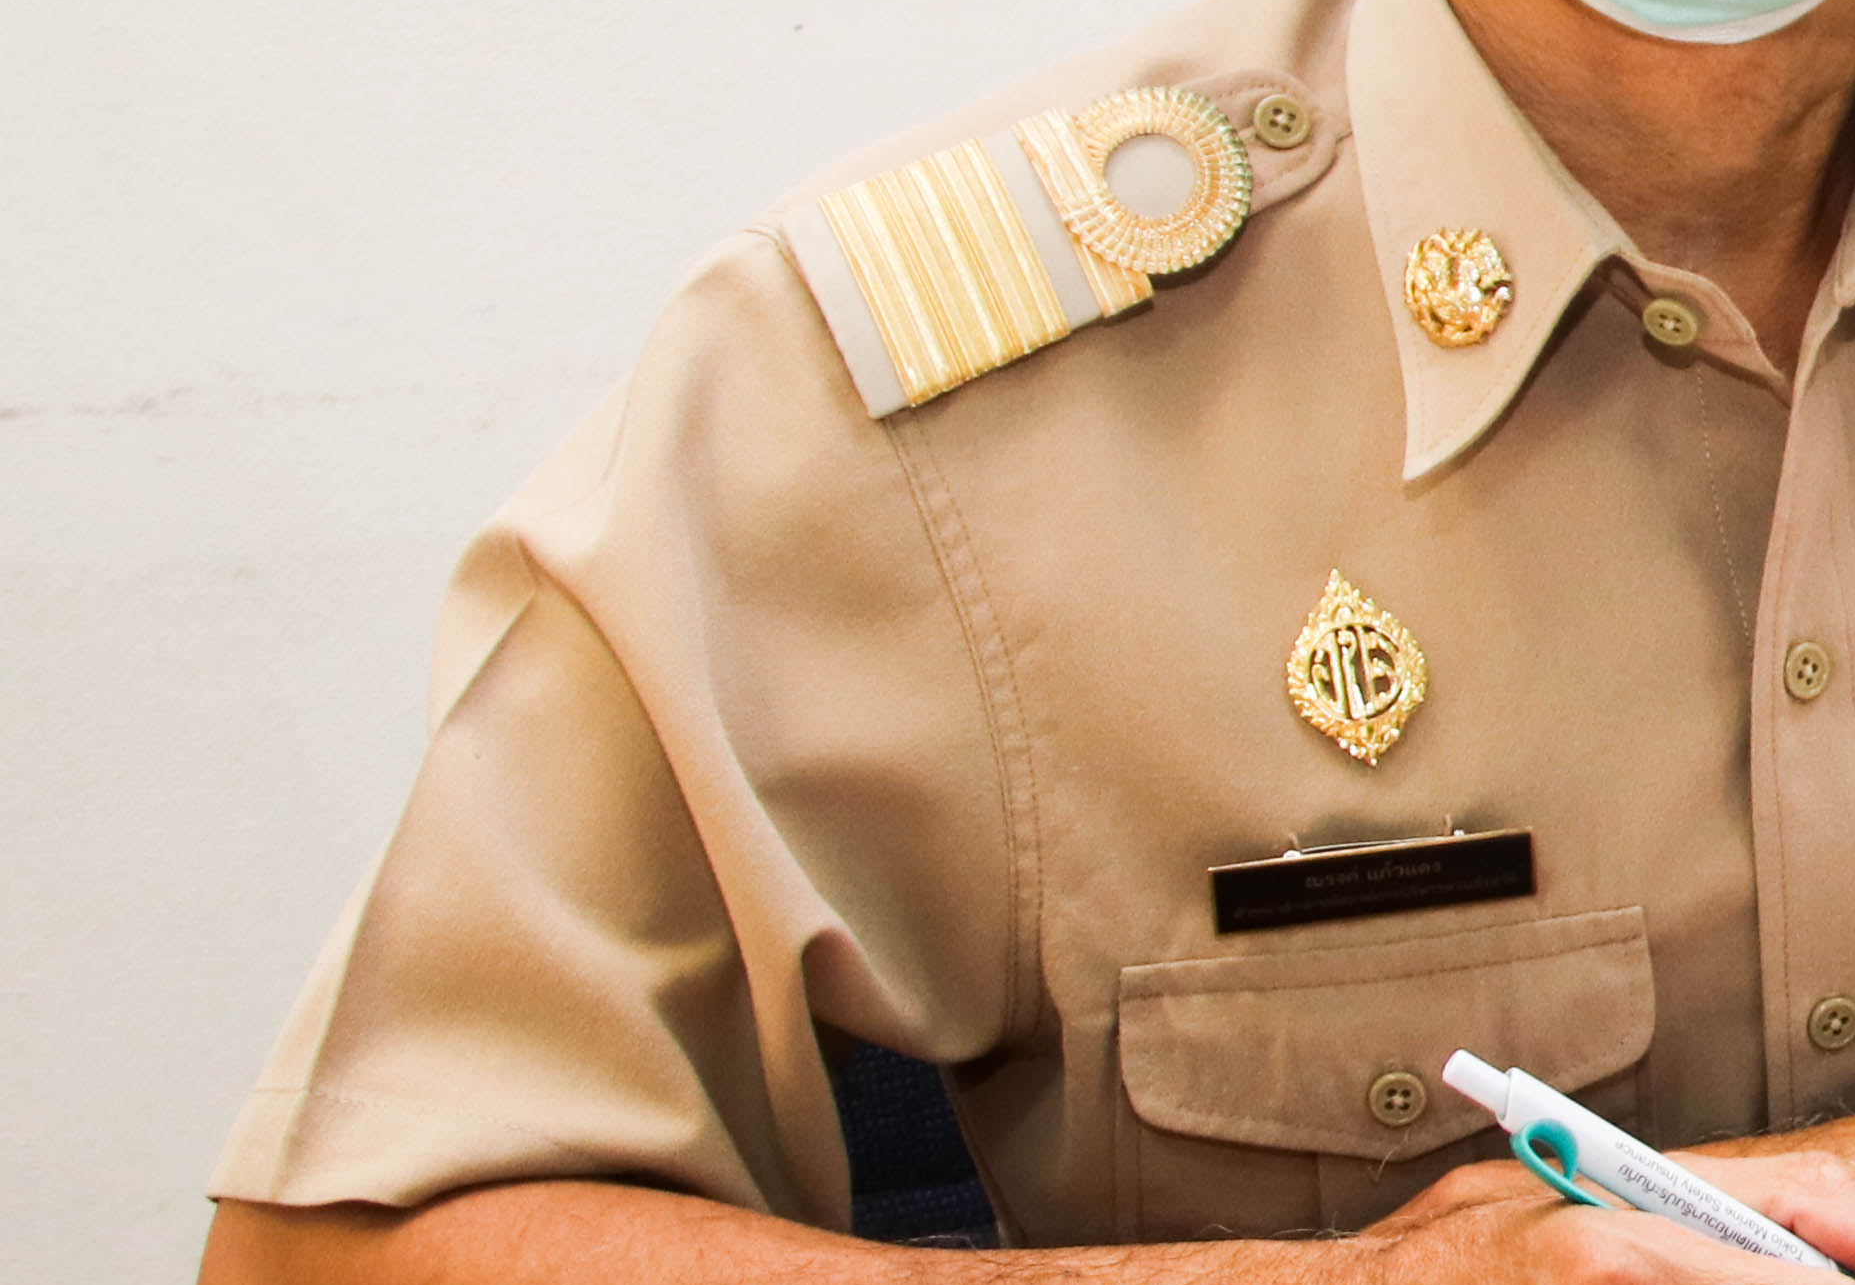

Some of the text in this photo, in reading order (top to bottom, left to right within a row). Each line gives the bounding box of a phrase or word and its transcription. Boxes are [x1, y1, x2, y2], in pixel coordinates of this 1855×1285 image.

[1614, 1138, 1806, 1262] Tokio Marine Safety Insurance
